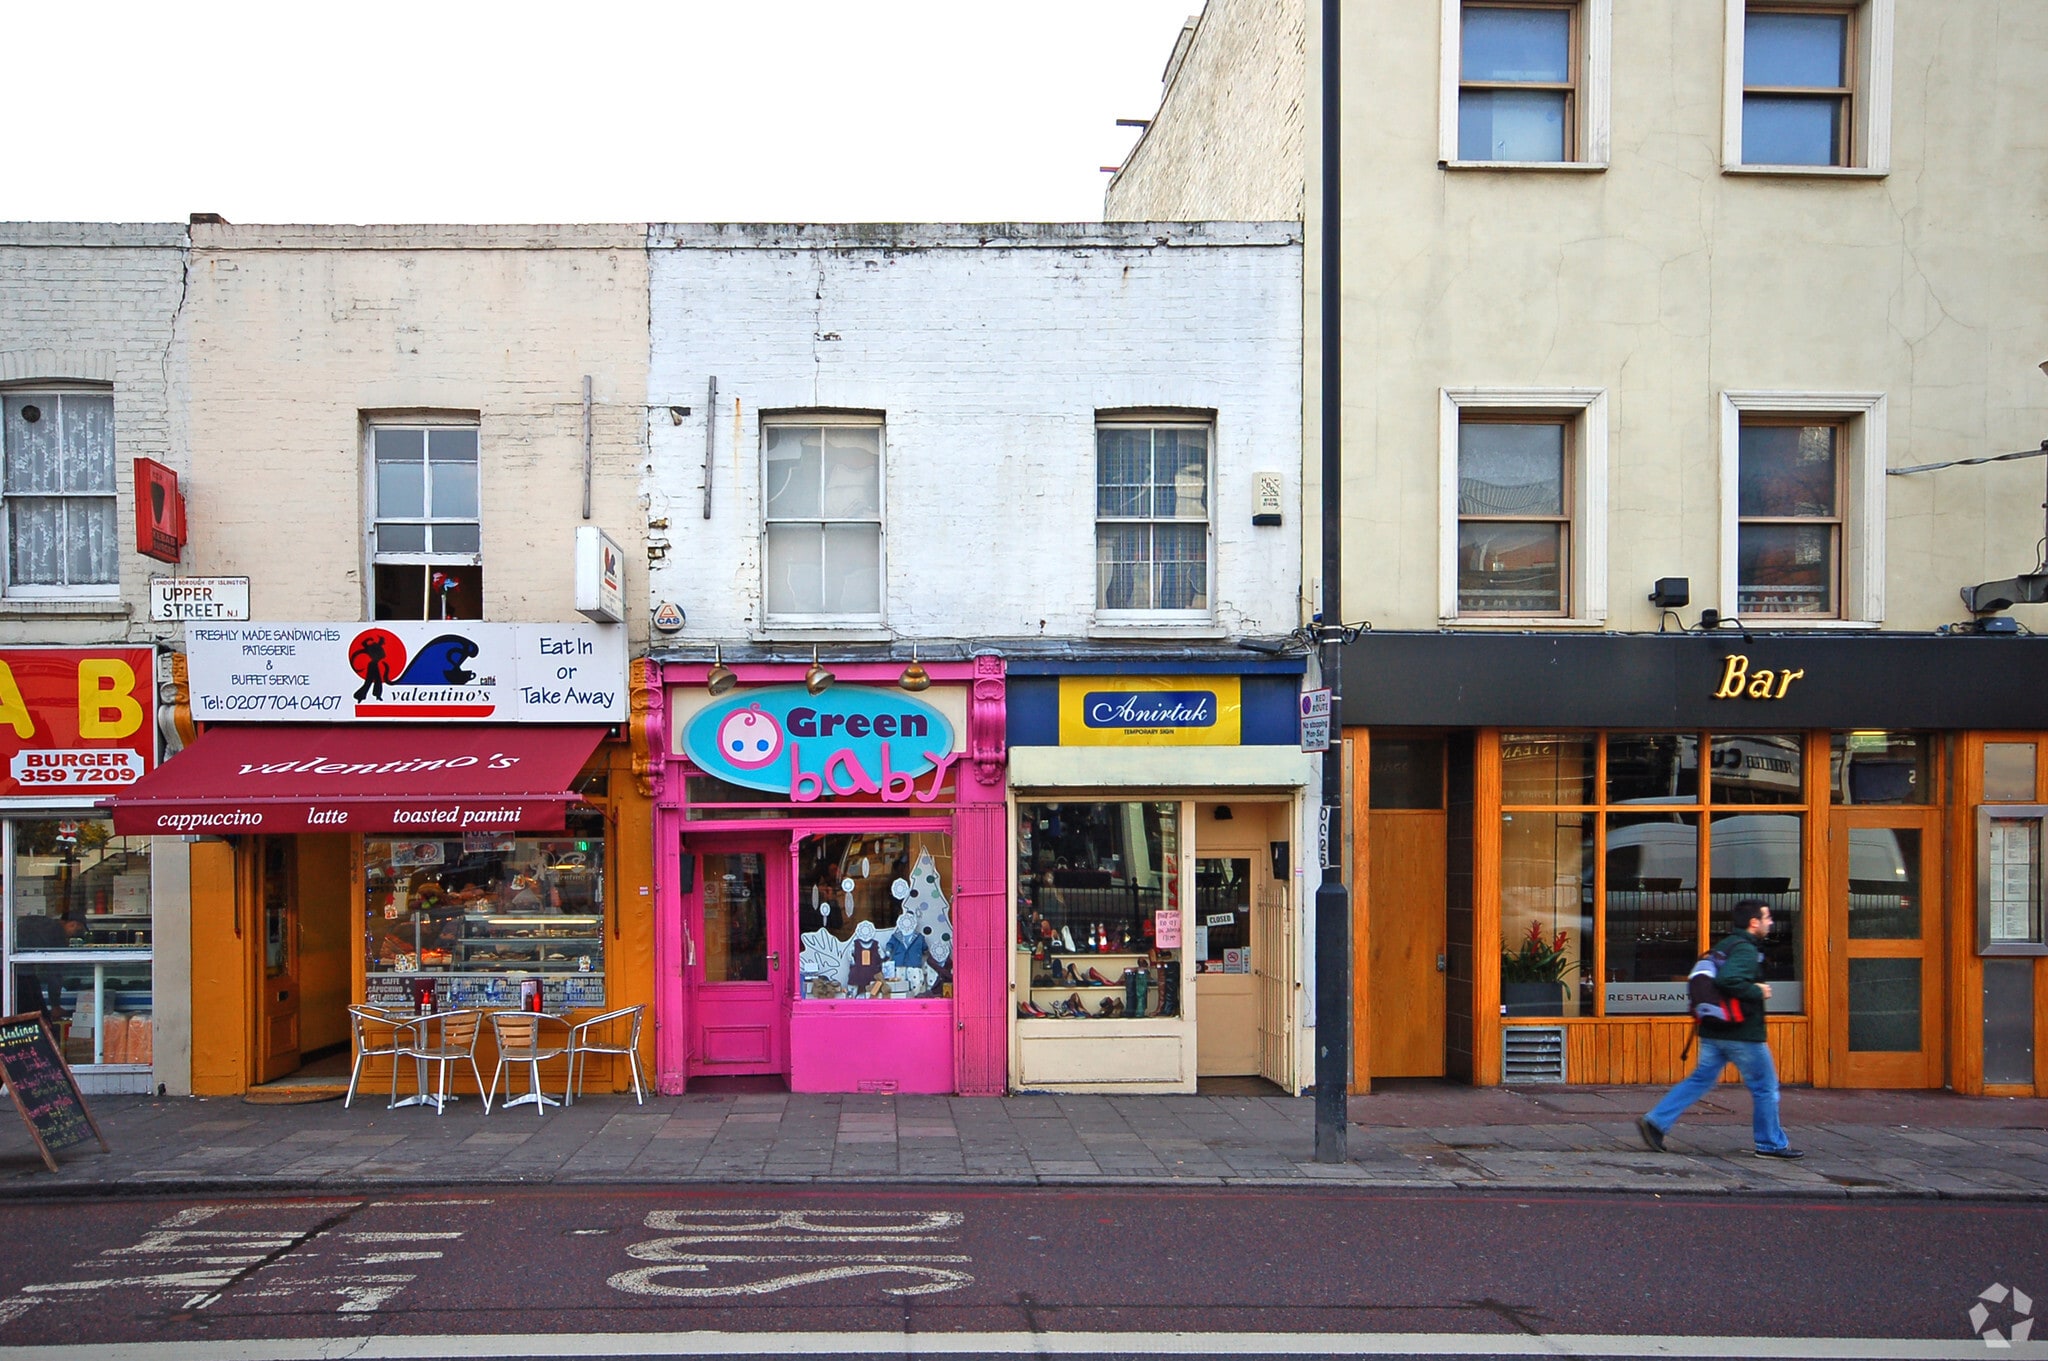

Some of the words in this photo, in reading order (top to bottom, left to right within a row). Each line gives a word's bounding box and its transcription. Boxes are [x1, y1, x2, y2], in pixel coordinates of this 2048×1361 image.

[162, 587, 212, 601] UPPER
[163, 603, 224, 618] STREET
[657, 617, 680, 625] CAS
[195, 629, 238, 641] FRESHLY
[242, 629, 272, 641] MADE
[273, 629, 340, 641] SANDWICHES
[242, 645, 296, 657] PATISSERIE
[540, 637, 573, 656] Eat
[577, 637, 593, 656] In
[265, 660, 274, 671] &
[231, 674, 268, 686] BUFFET
[269, 674, 310, 686] SERVICE
[556, 667, 577, 681] or
[1714, 654, 1804, 699] Bar
[390, 687, 491, 702] valentino's
[520, 688, 561, 705] Take
[563, 688, 615, 708] Away
[1316, 694, 1326, 703] RED
[201, 695, 224, 711] Tel:
[1092, 695, 1208, 722] Anirtak
[1312, 702, 1328, 712] ROUTE
[786, 706, 928, 738] Green
[26, 753, 130, 767] BURGER
[238, 752, 521, 776] valentino's
[20, 768, 67, 783] 359
[74, 768, 136, 783] 7209
[789, 741, 959, 802] baby
[157, 809, 263, 830] cappuccino
[307, 807, 349, 825] latte
[392, 806, 460, 823] toasted
[460, 806, 523, 827] panini
[1209, 914, 1232, 924] CLOSED
[1608, 993, 1692, 1002] RESTAURANT
[606, 1209, 976, 1298] BUS
